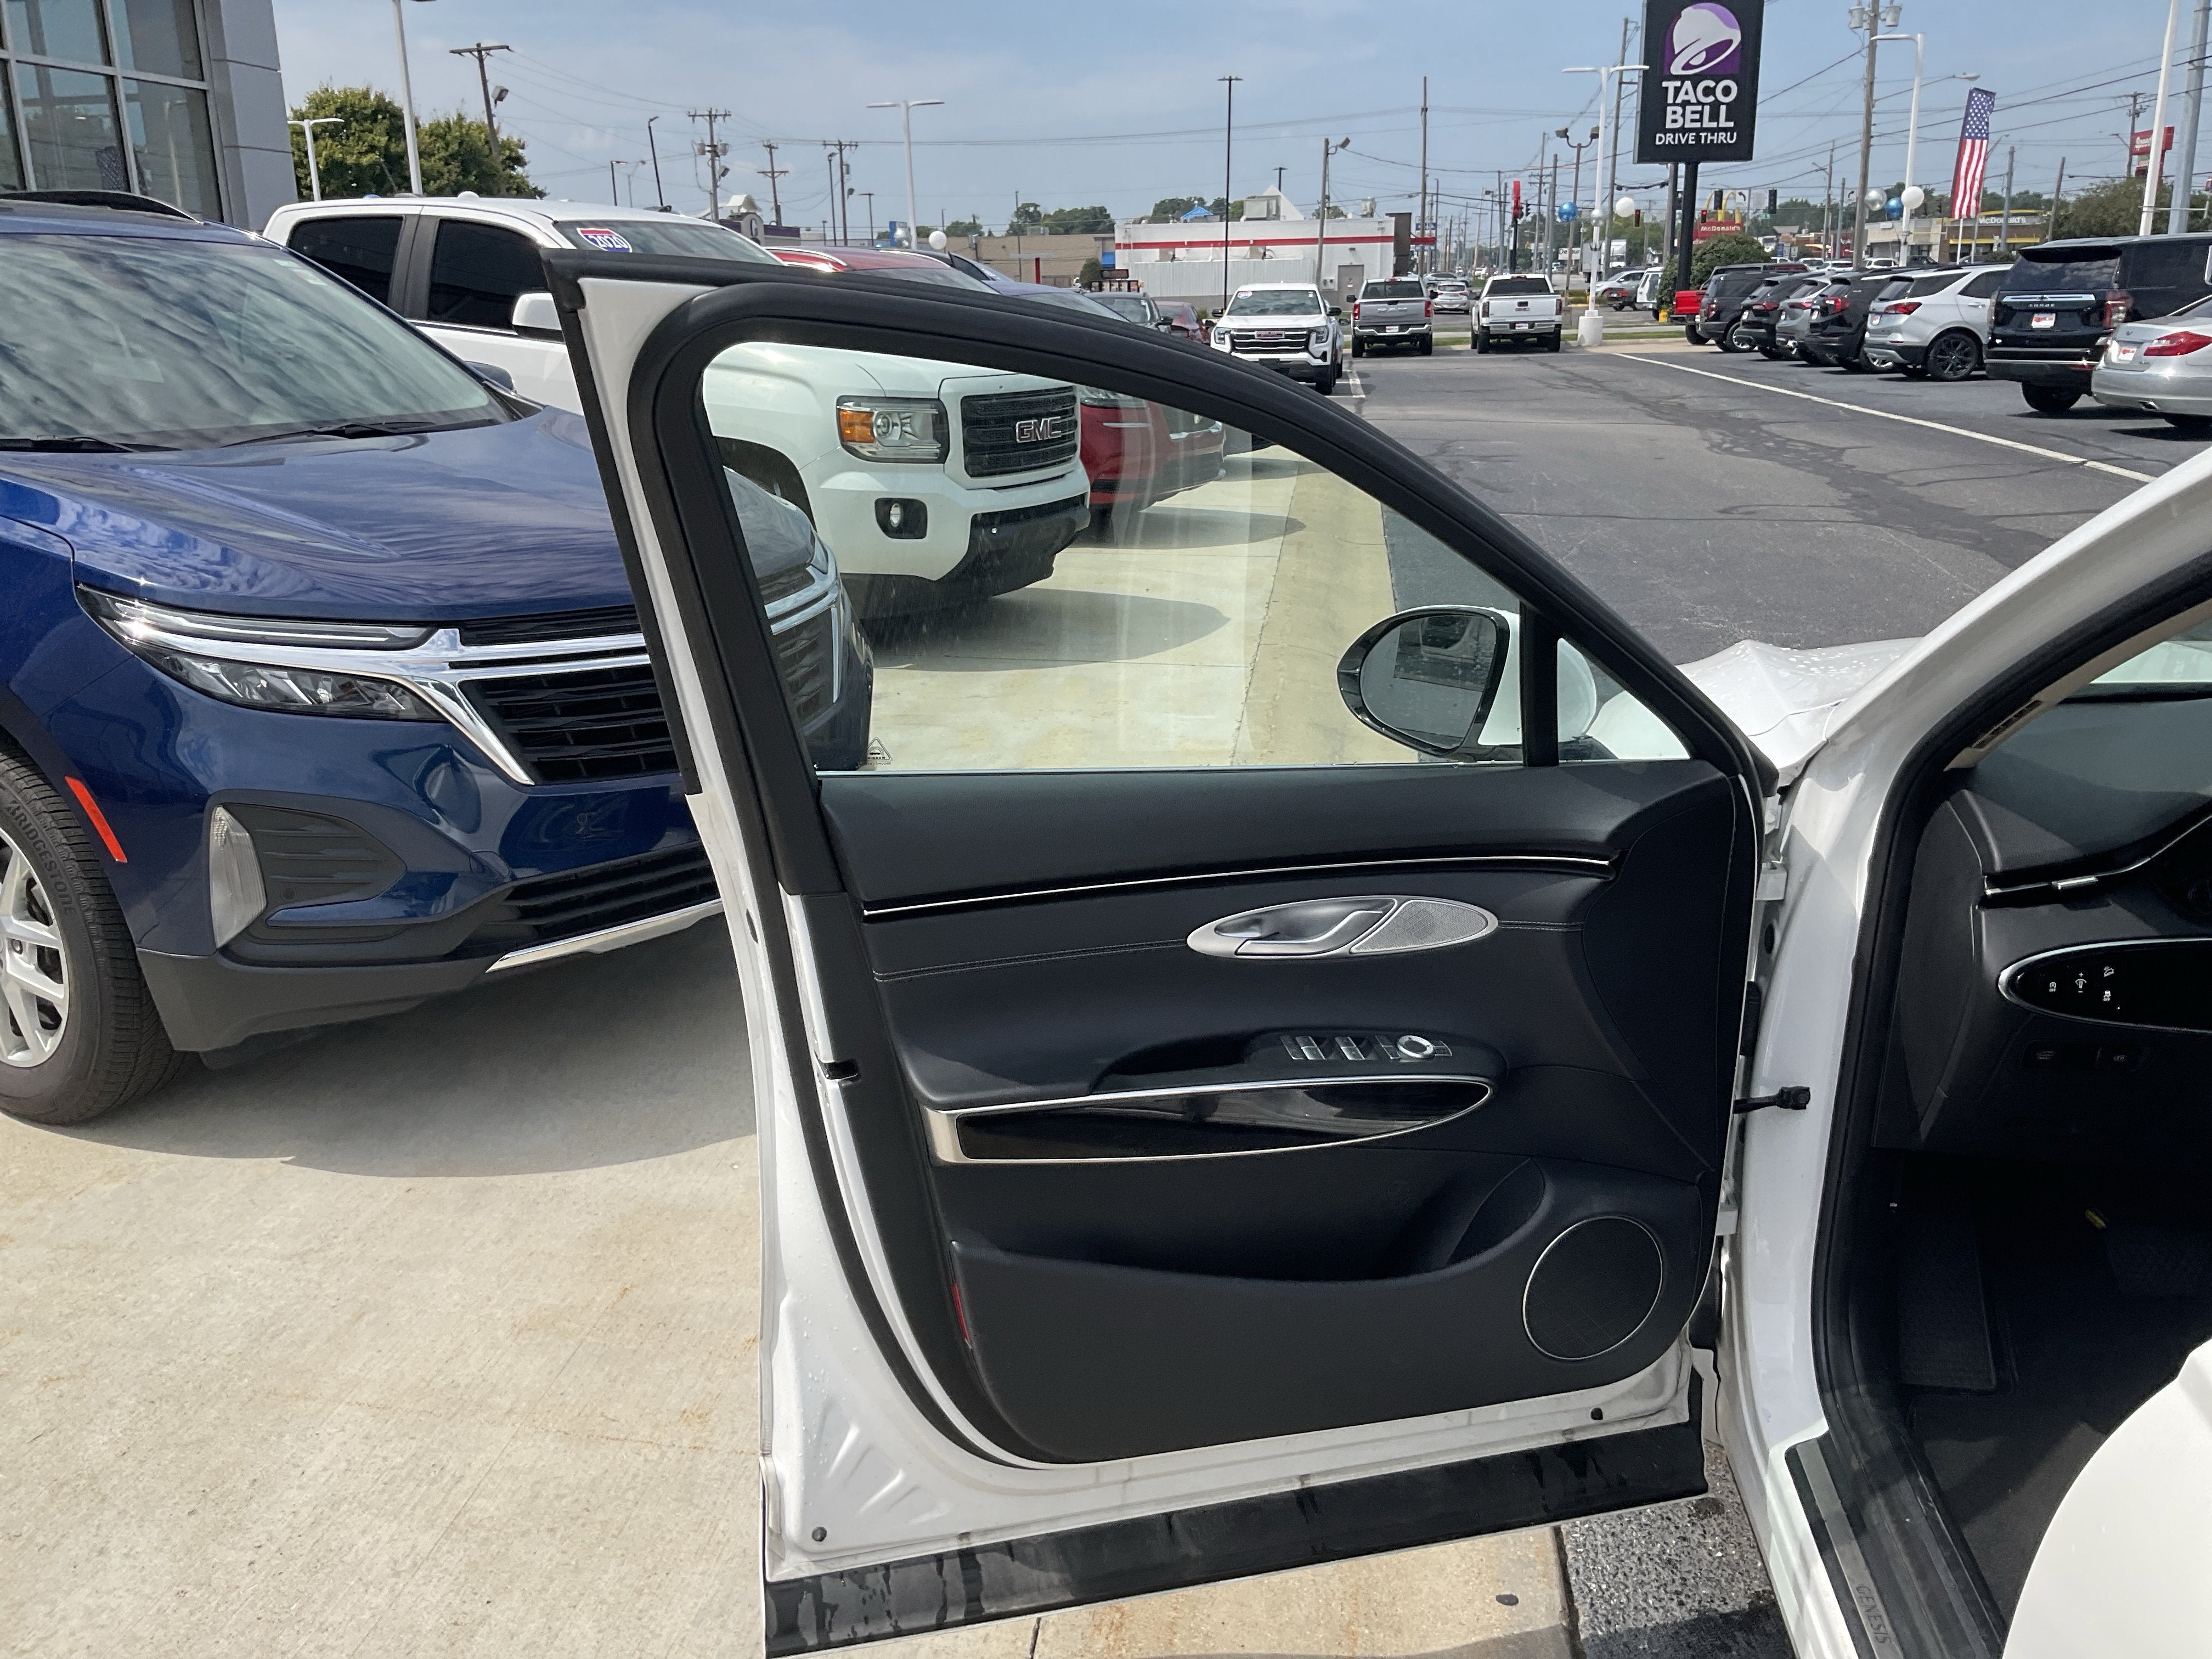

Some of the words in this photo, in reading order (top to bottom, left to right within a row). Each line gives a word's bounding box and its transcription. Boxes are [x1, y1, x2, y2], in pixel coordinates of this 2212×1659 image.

[1662, 80, 1737, 104] TACO
[1666, 105, 1734, 129] BELL
[1656, 132, 1696, 145] DRIVE
[1699, 132, 1737, 144] THRU
[588, 235, 629, 249] 2020
[1016, 416, 1062, 443] GMC
[6, 799, 77, 916] BRIDGESTONE
[1856, 1585, 1892, 1644] GENESIS
